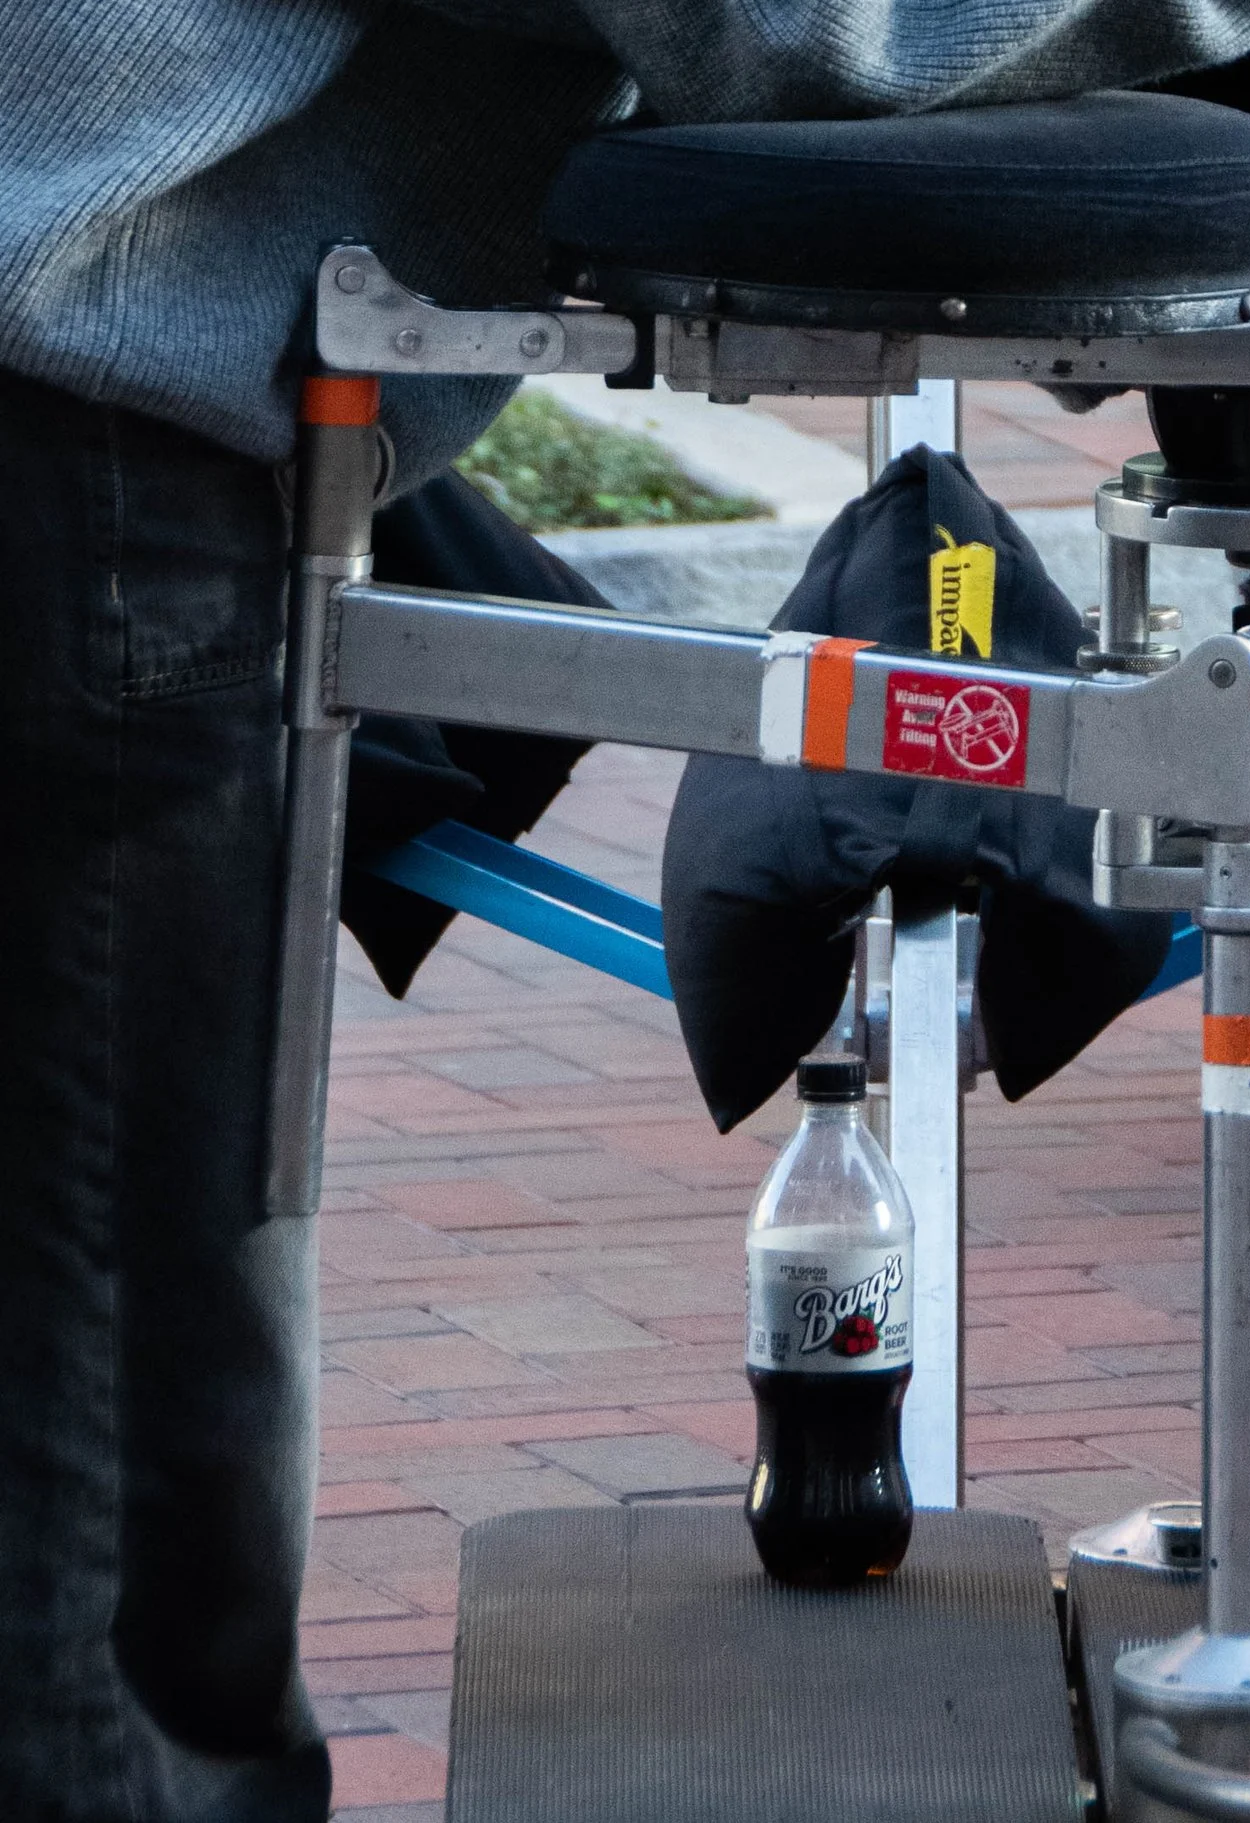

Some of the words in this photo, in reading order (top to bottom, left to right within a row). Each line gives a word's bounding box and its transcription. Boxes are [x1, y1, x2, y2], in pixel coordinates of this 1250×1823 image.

[895, 689, 946, 710] Warning
[798, 1266, 828, 1276] GOOD
[794, 1254, 903, 1354] Barq's
[885, 1321, 908, 1336] ROOT
[885, 1336, 907, 1350] BEER
